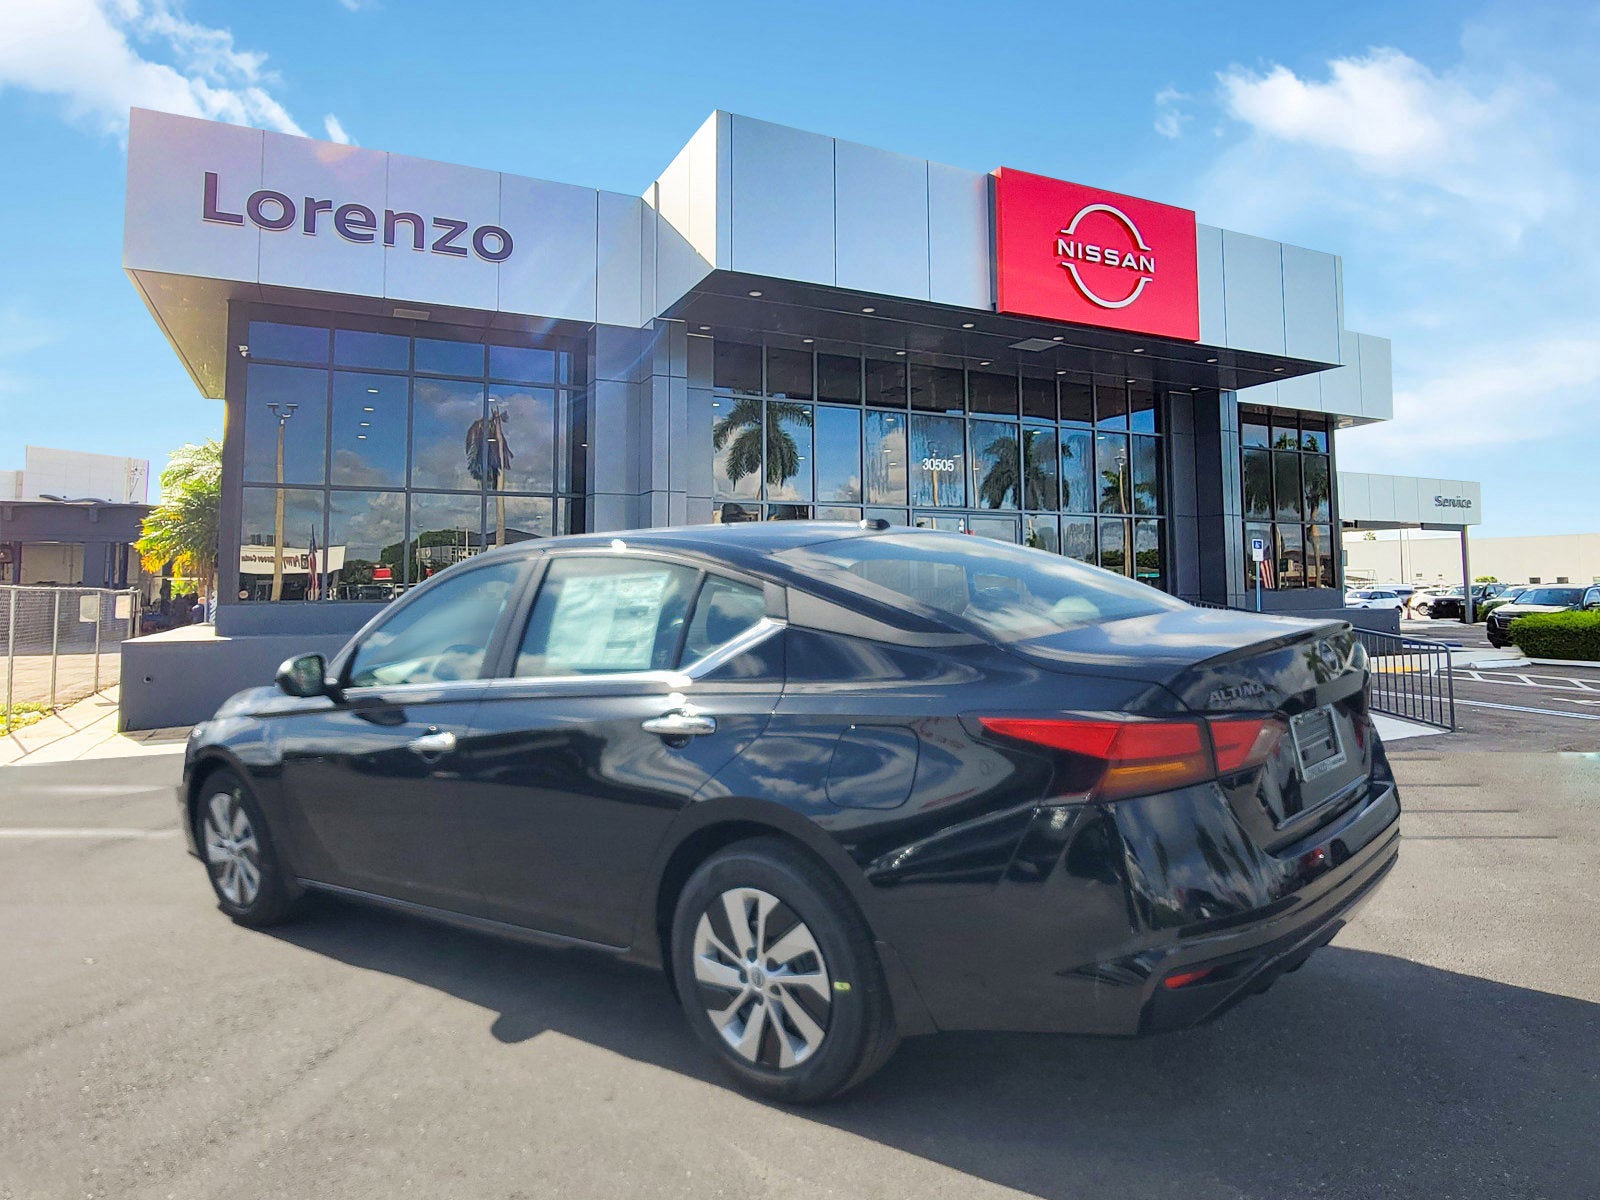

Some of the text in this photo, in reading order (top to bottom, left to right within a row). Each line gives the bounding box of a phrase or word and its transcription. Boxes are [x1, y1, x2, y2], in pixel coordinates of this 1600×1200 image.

[203, 171, 514, 262] Lorenzo
[1057, 238, 1155, 273] NISSAN
[922, 457, 955, 472] 30505
[1434, 495, 1472, 509] Service
[1208, 684, 1266, 703] ALTIMA
